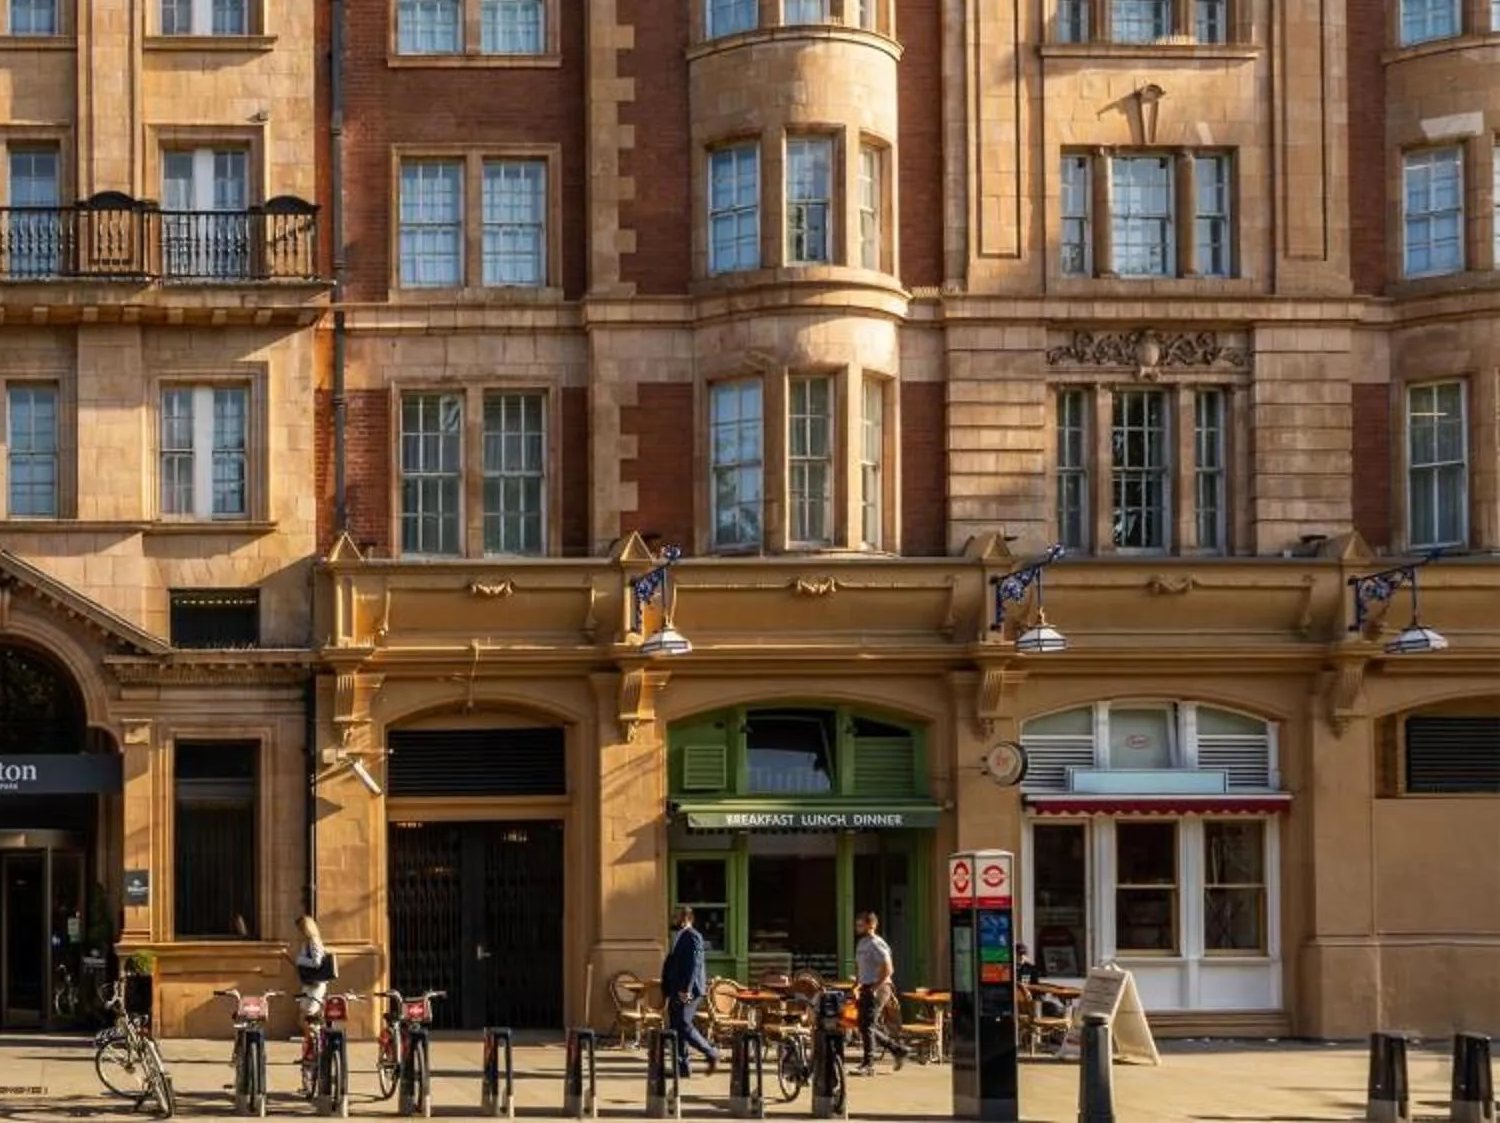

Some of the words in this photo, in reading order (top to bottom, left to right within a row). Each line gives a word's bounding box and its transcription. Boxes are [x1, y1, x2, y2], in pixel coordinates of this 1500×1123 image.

[726, 813, 794, 826] BREAKFAST
[801, 814, 846, 826] LUNCH
[853, 814, 903, 826] DINNER
